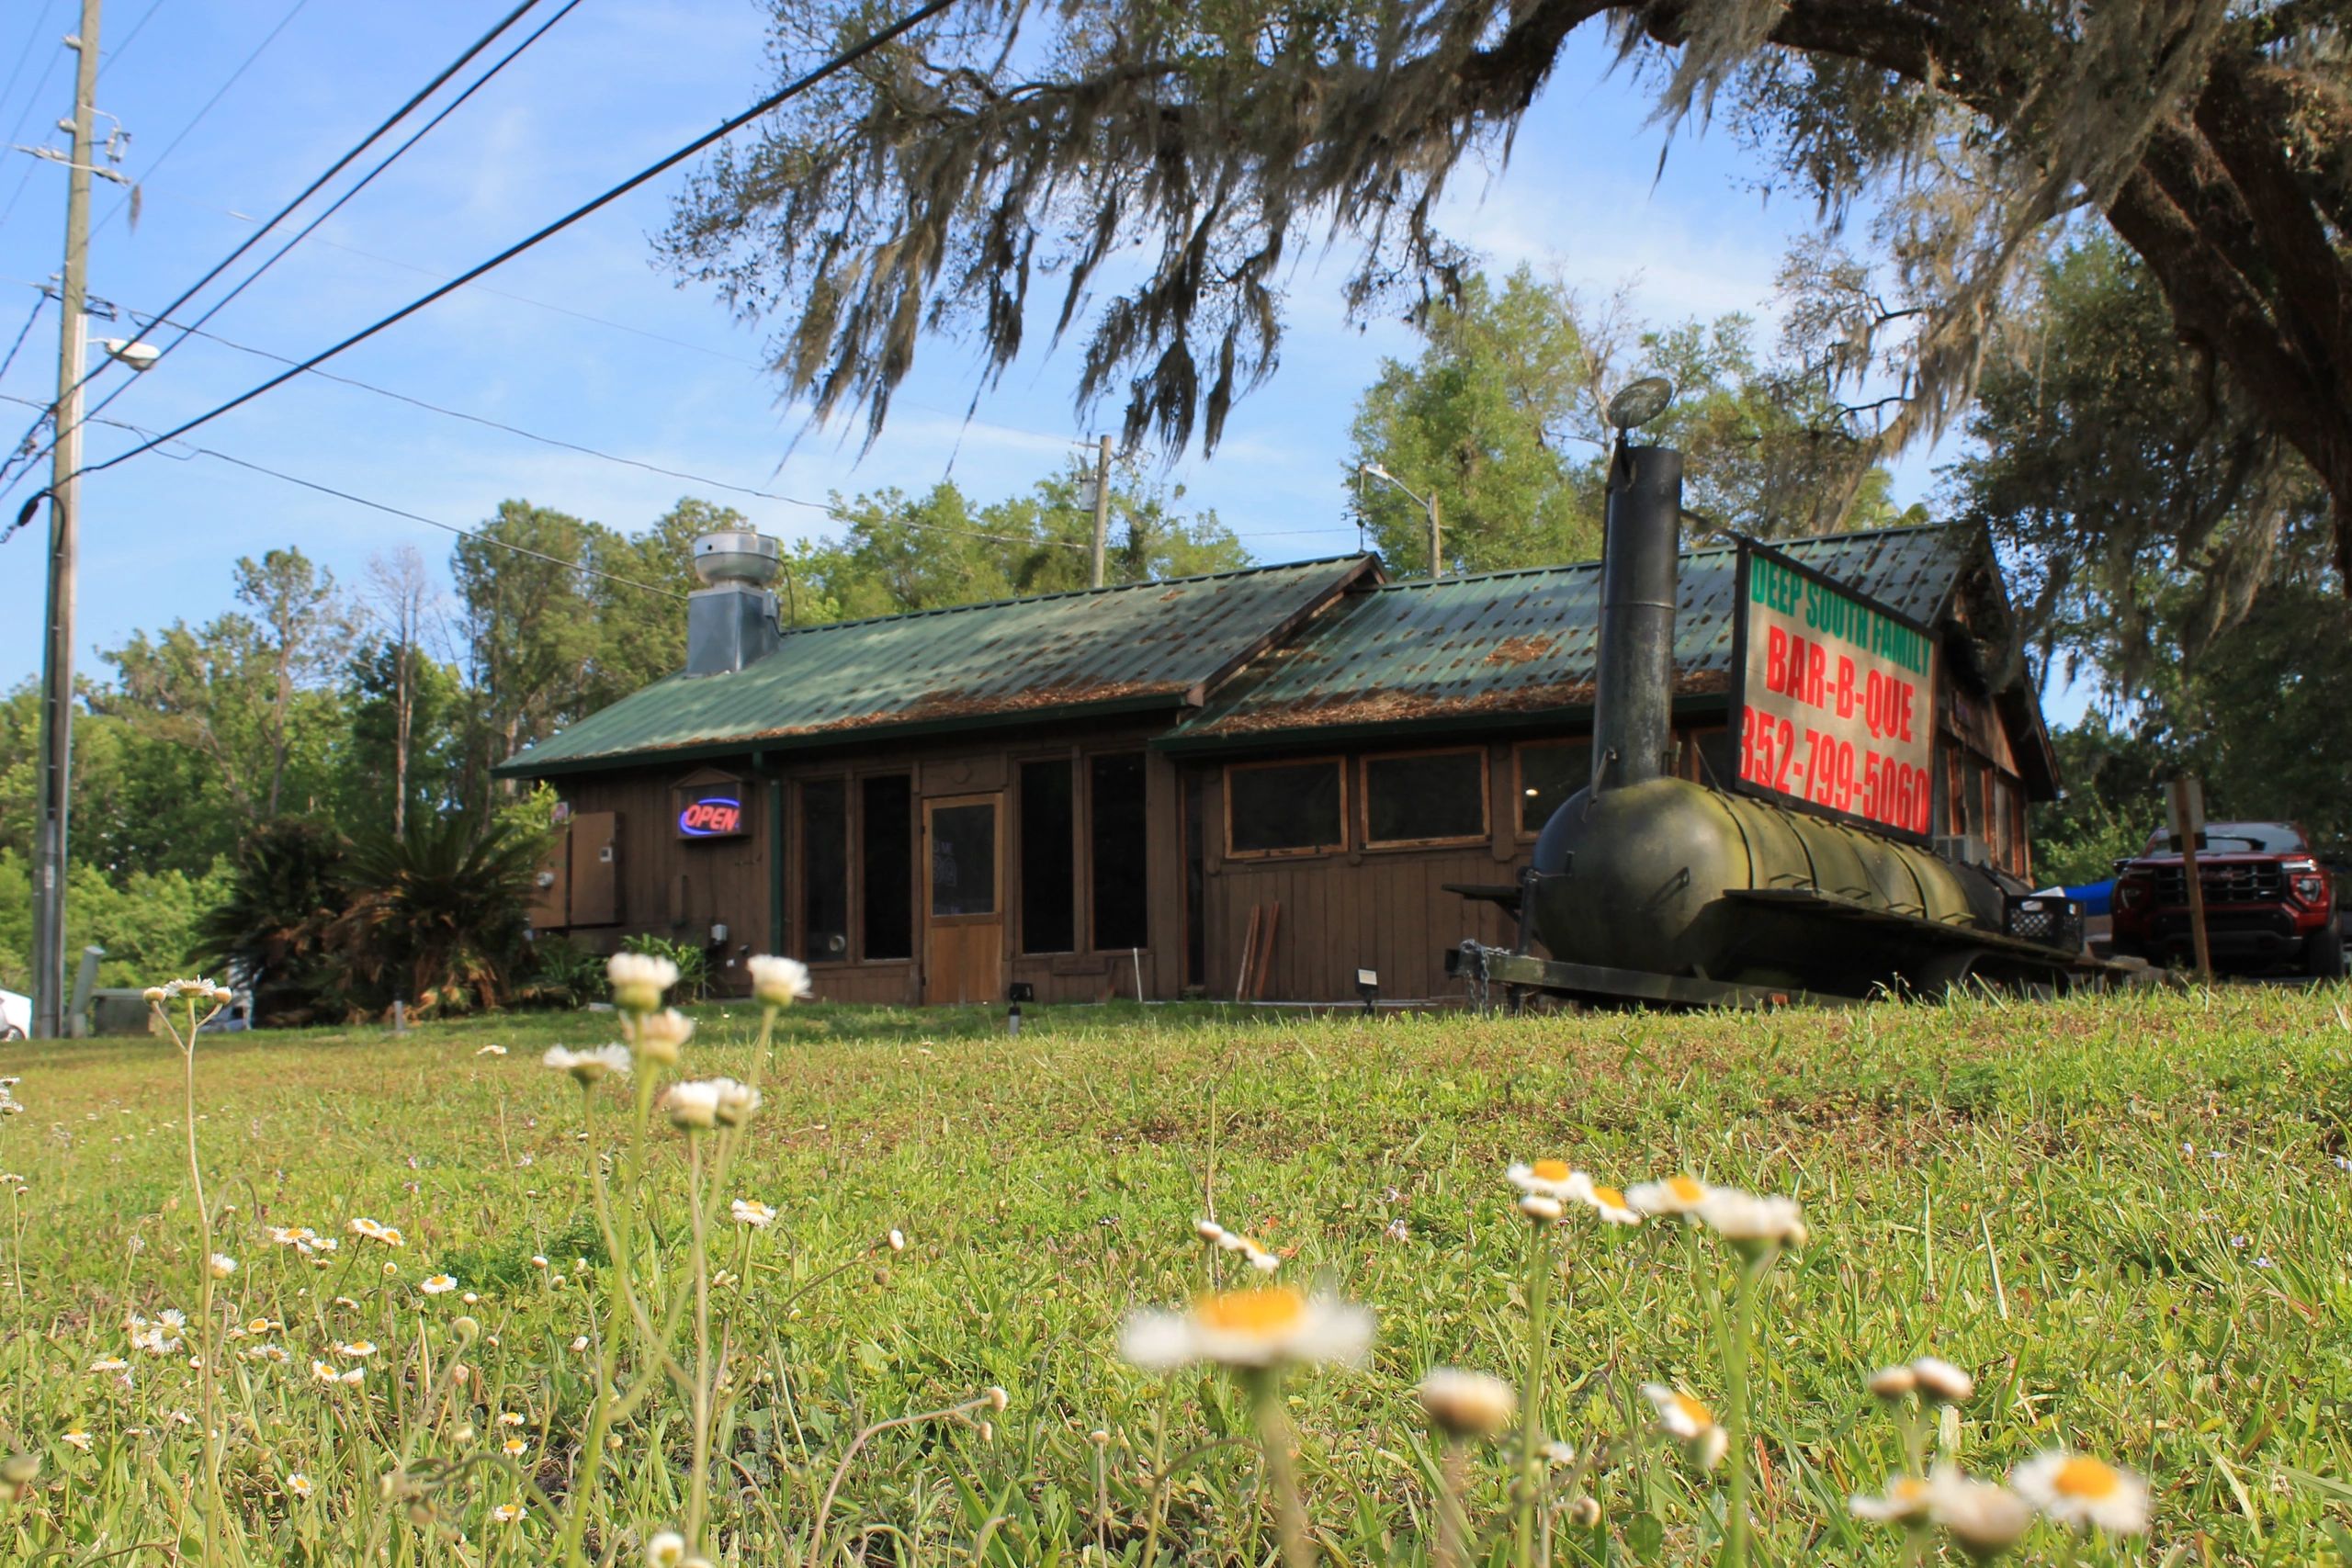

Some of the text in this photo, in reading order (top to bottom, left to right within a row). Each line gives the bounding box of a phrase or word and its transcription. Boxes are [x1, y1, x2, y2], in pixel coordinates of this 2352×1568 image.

[1751, 554, 1931, 678] DEEP SOUTH FAMILY
[1766, 625, 1914, 743] BAR-B-QUE
[684, 804, 740, 832] OPEN
[1739, 705, 1929, 835] 352-799-5060
